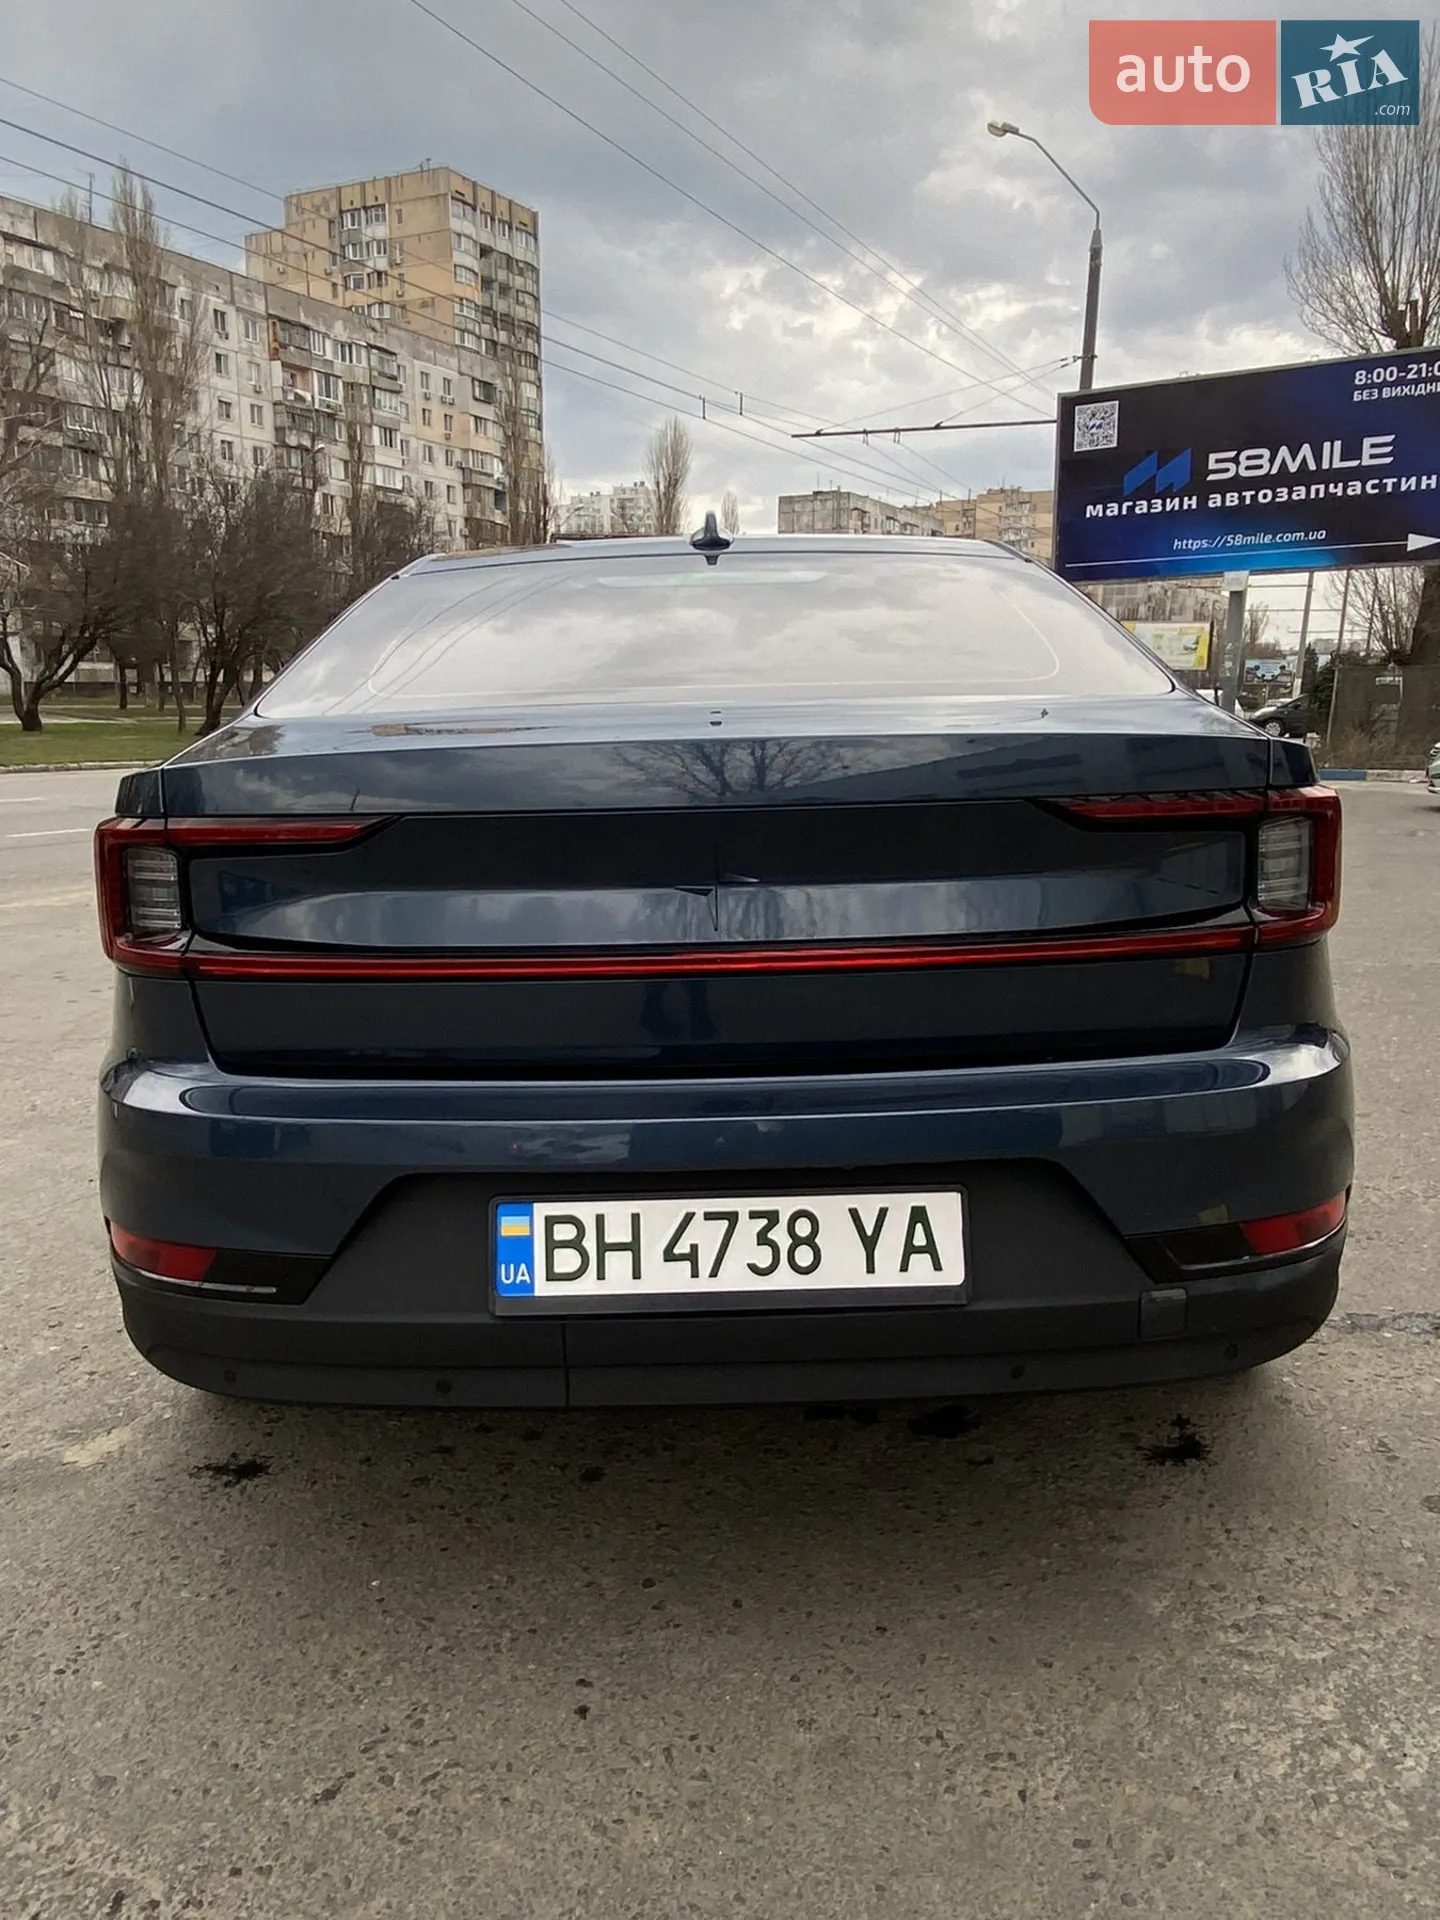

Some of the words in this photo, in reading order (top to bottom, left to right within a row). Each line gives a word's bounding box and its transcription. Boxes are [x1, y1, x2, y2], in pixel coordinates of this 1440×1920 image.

[1353, 388, 1379, 402] БЕЗ
[1206, 434, 1396, 481] 58MILE
[1085, 494, 1198, 519] магазин
[1207, 474, 1438, 508] автозапчастин
[1173, 529, 1327, 551] https://58mile.com.ua
[544, 1212, 642, 1282] BH
[663, 1208, 822, 1279] 4738
[847, 1205, 943, 1274] YA
[501, 1263, 530, 1284] UA
